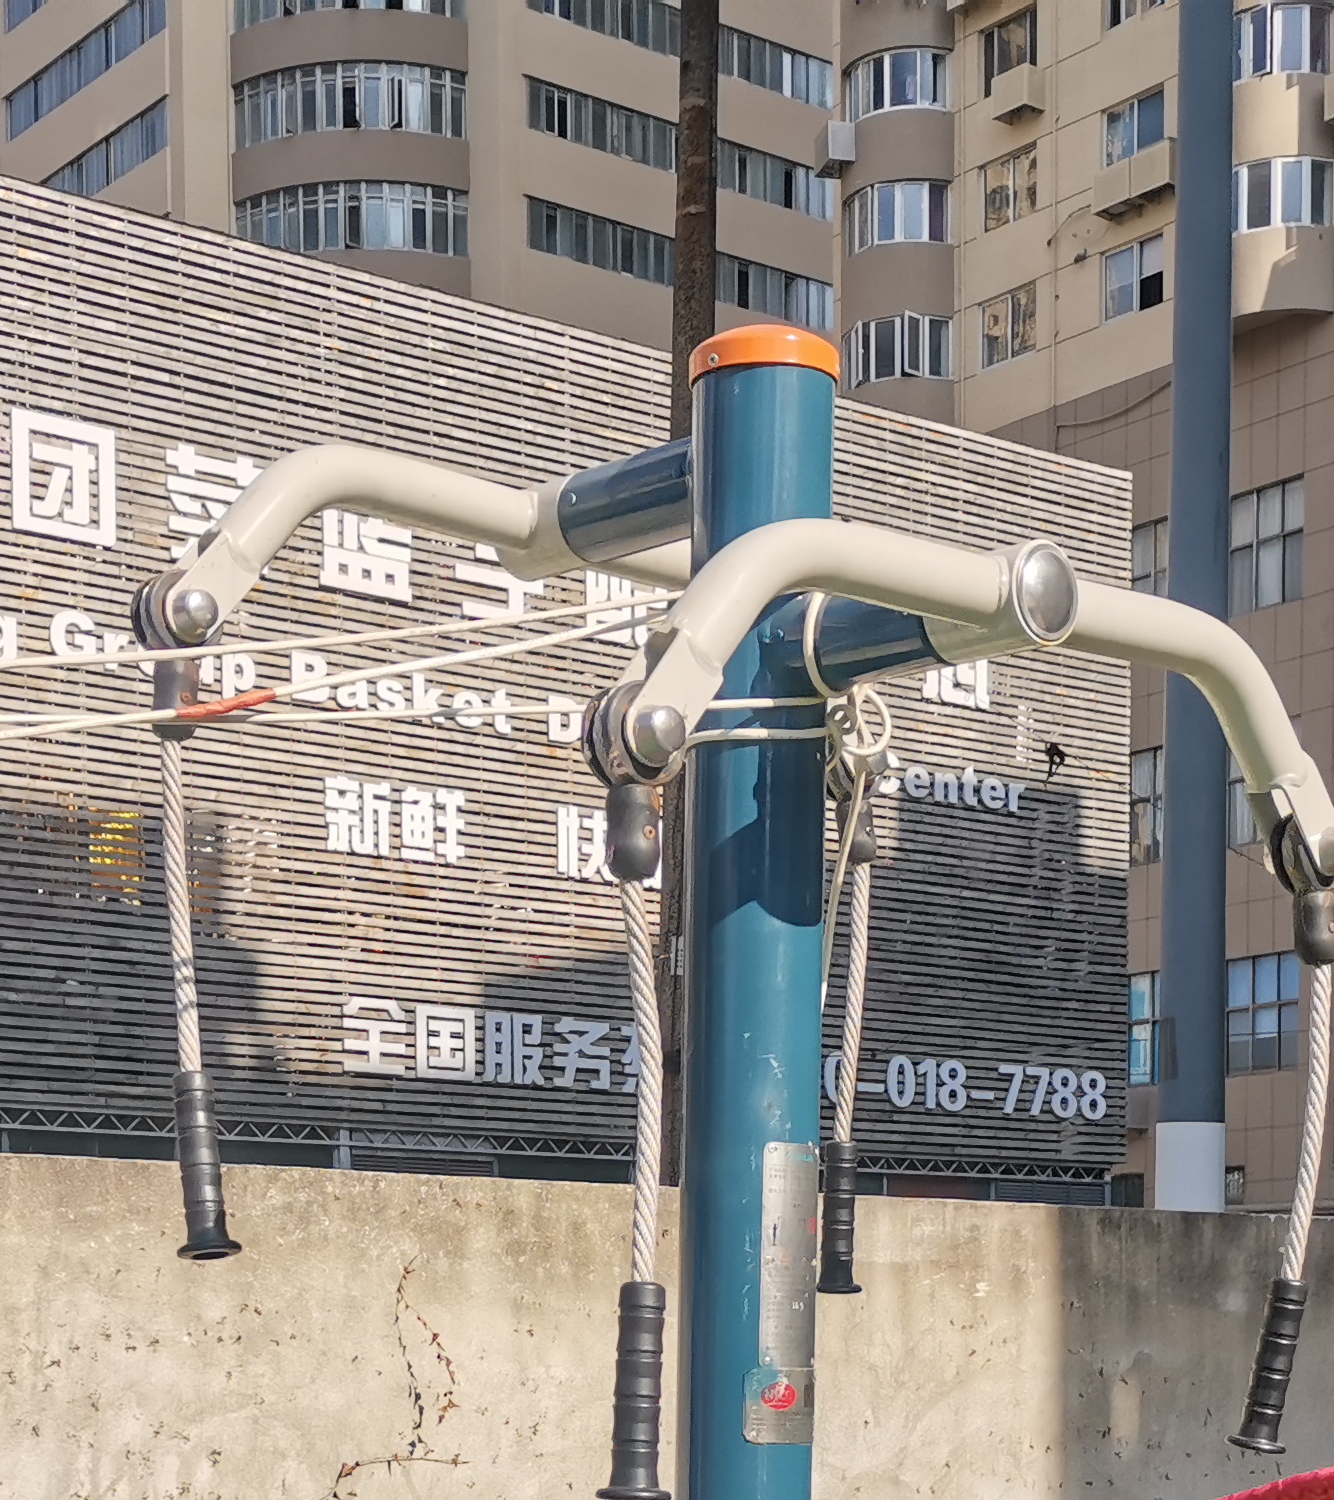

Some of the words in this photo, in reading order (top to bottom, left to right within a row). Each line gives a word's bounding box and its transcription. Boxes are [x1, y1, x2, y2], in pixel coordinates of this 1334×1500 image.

[49, 610, 256, 700] Grp
[289, 651, 512, 735] Basket
[324, 774, 465, 865] 新鲜
[341, 998, 640, 1093] 全国服务
